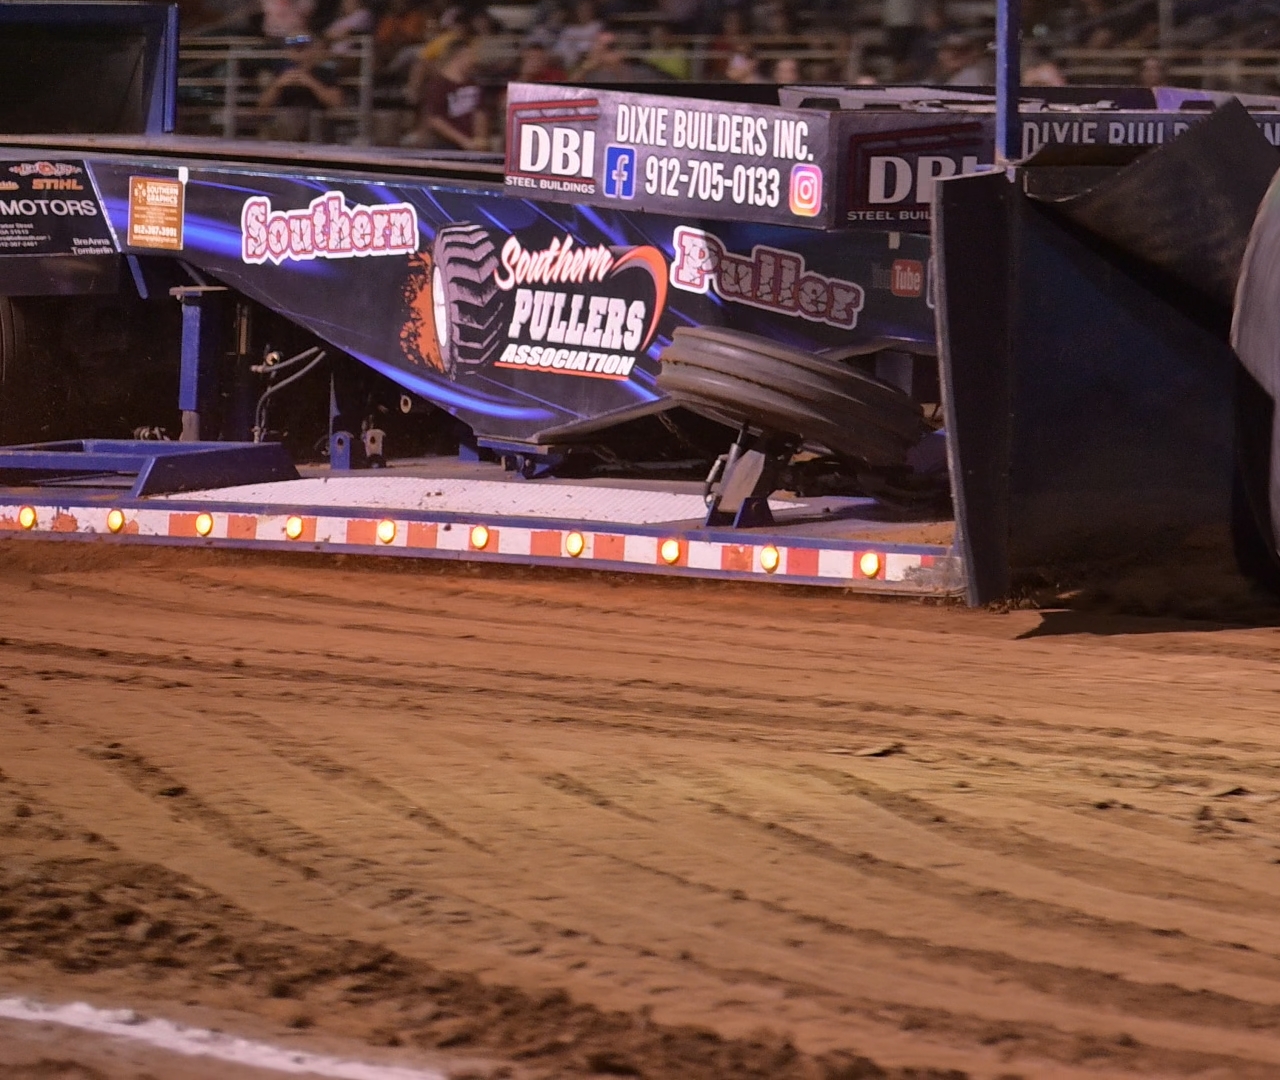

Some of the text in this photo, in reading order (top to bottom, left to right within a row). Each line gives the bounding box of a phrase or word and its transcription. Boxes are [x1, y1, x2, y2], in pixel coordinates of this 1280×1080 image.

[615, 104, 815, 162] DIXIE BUILDERS INC.
[519, 124, 596, 178] DBI
[32, 178, 84, 190] STIHL
[505, 175, 596, 195] STEEL BUILDINGS
[645, 155, 781, 208] 912-705-0133
[0, 199, 98, 217] MOTORS
[847, 210, 895, 221] STEEL
[72, 237, 110, 246] BreAnna
[244, 194, 416, 261] Southern
[71, 246, 114, 256] Tomberlin
[495, 234, 616, 291] Southern
[508, 288, 647, 352] PULLERS
[500, 343, 636, 376] ASSOCIATION
